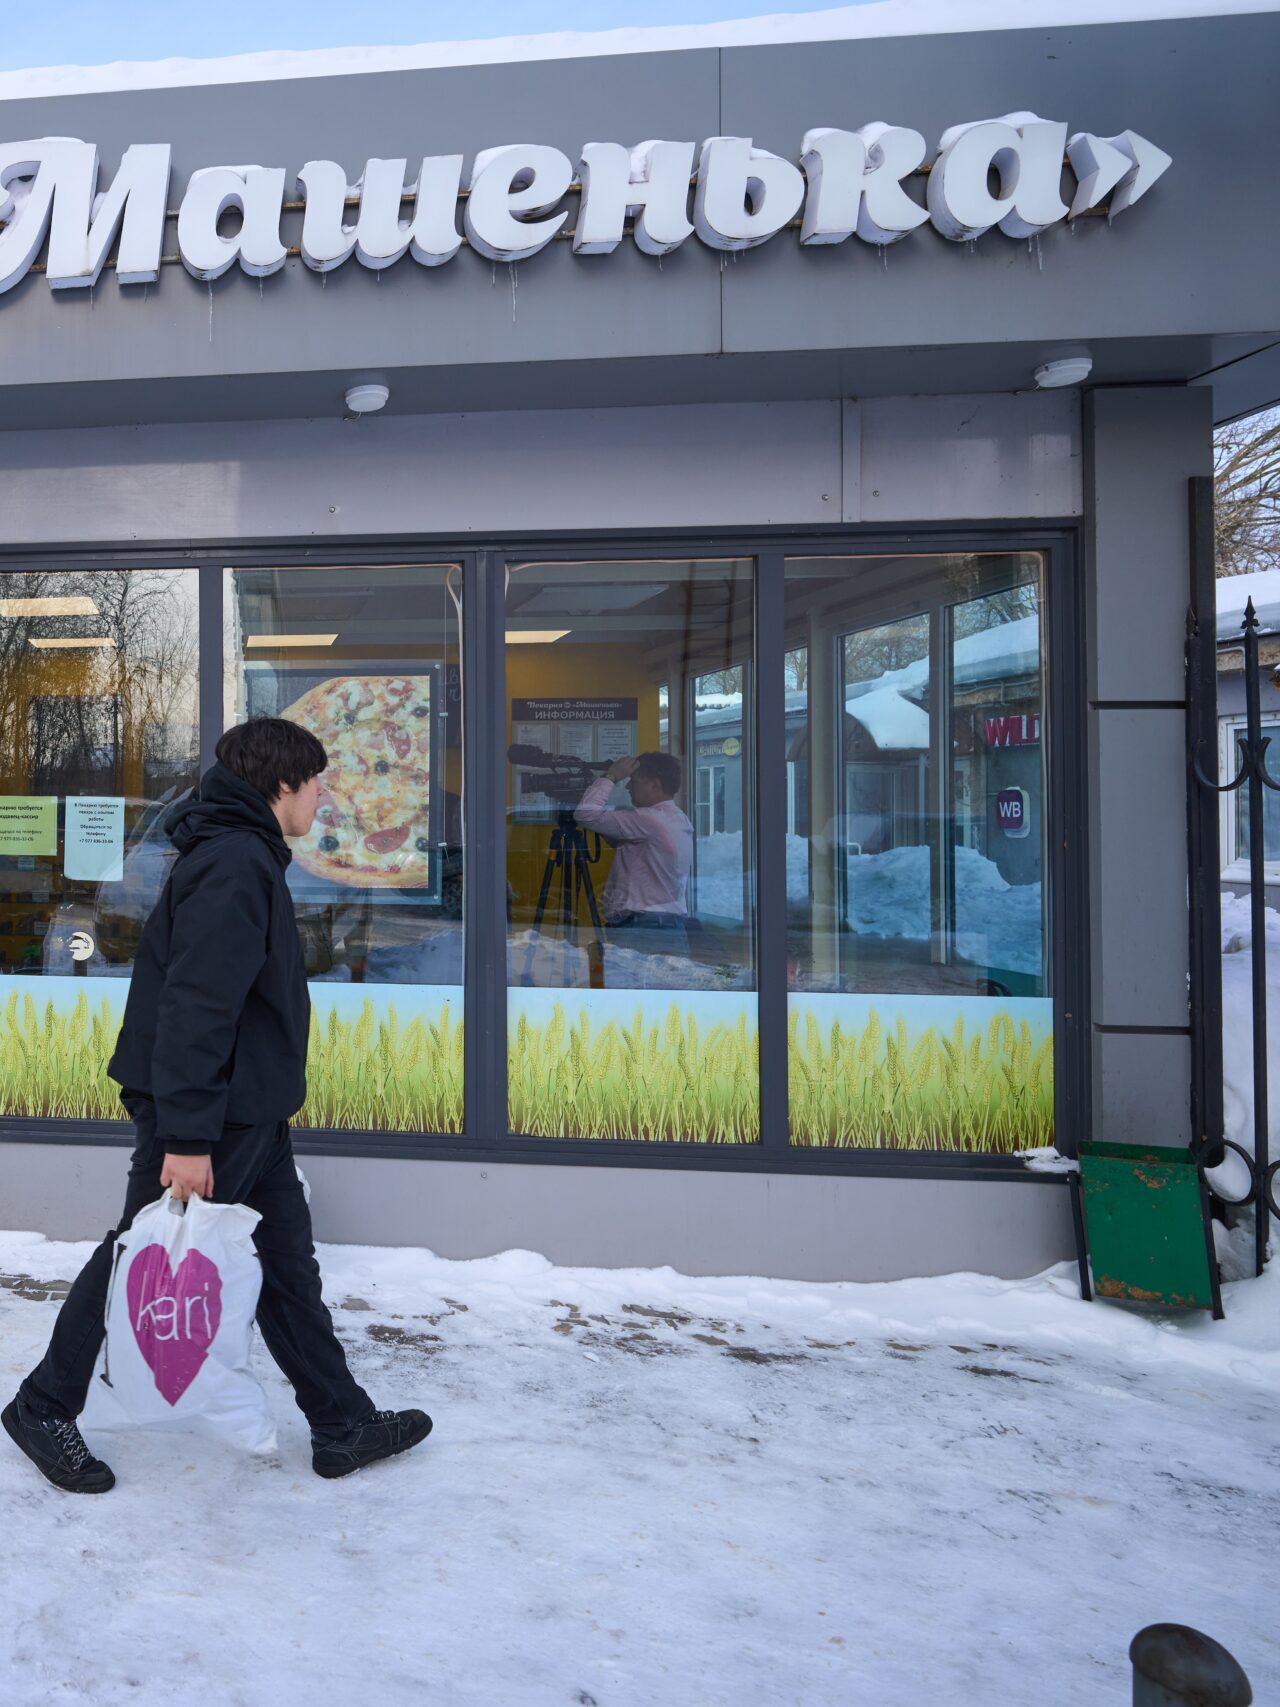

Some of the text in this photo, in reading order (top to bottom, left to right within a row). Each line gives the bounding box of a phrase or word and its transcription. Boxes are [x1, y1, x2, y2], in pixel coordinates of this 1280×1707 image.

[535, 711, 615, 720] ИНФОРМАЦИЯ
[999, 801, 1021, 818] WB
[136, 1271, 212, 1341] kari
